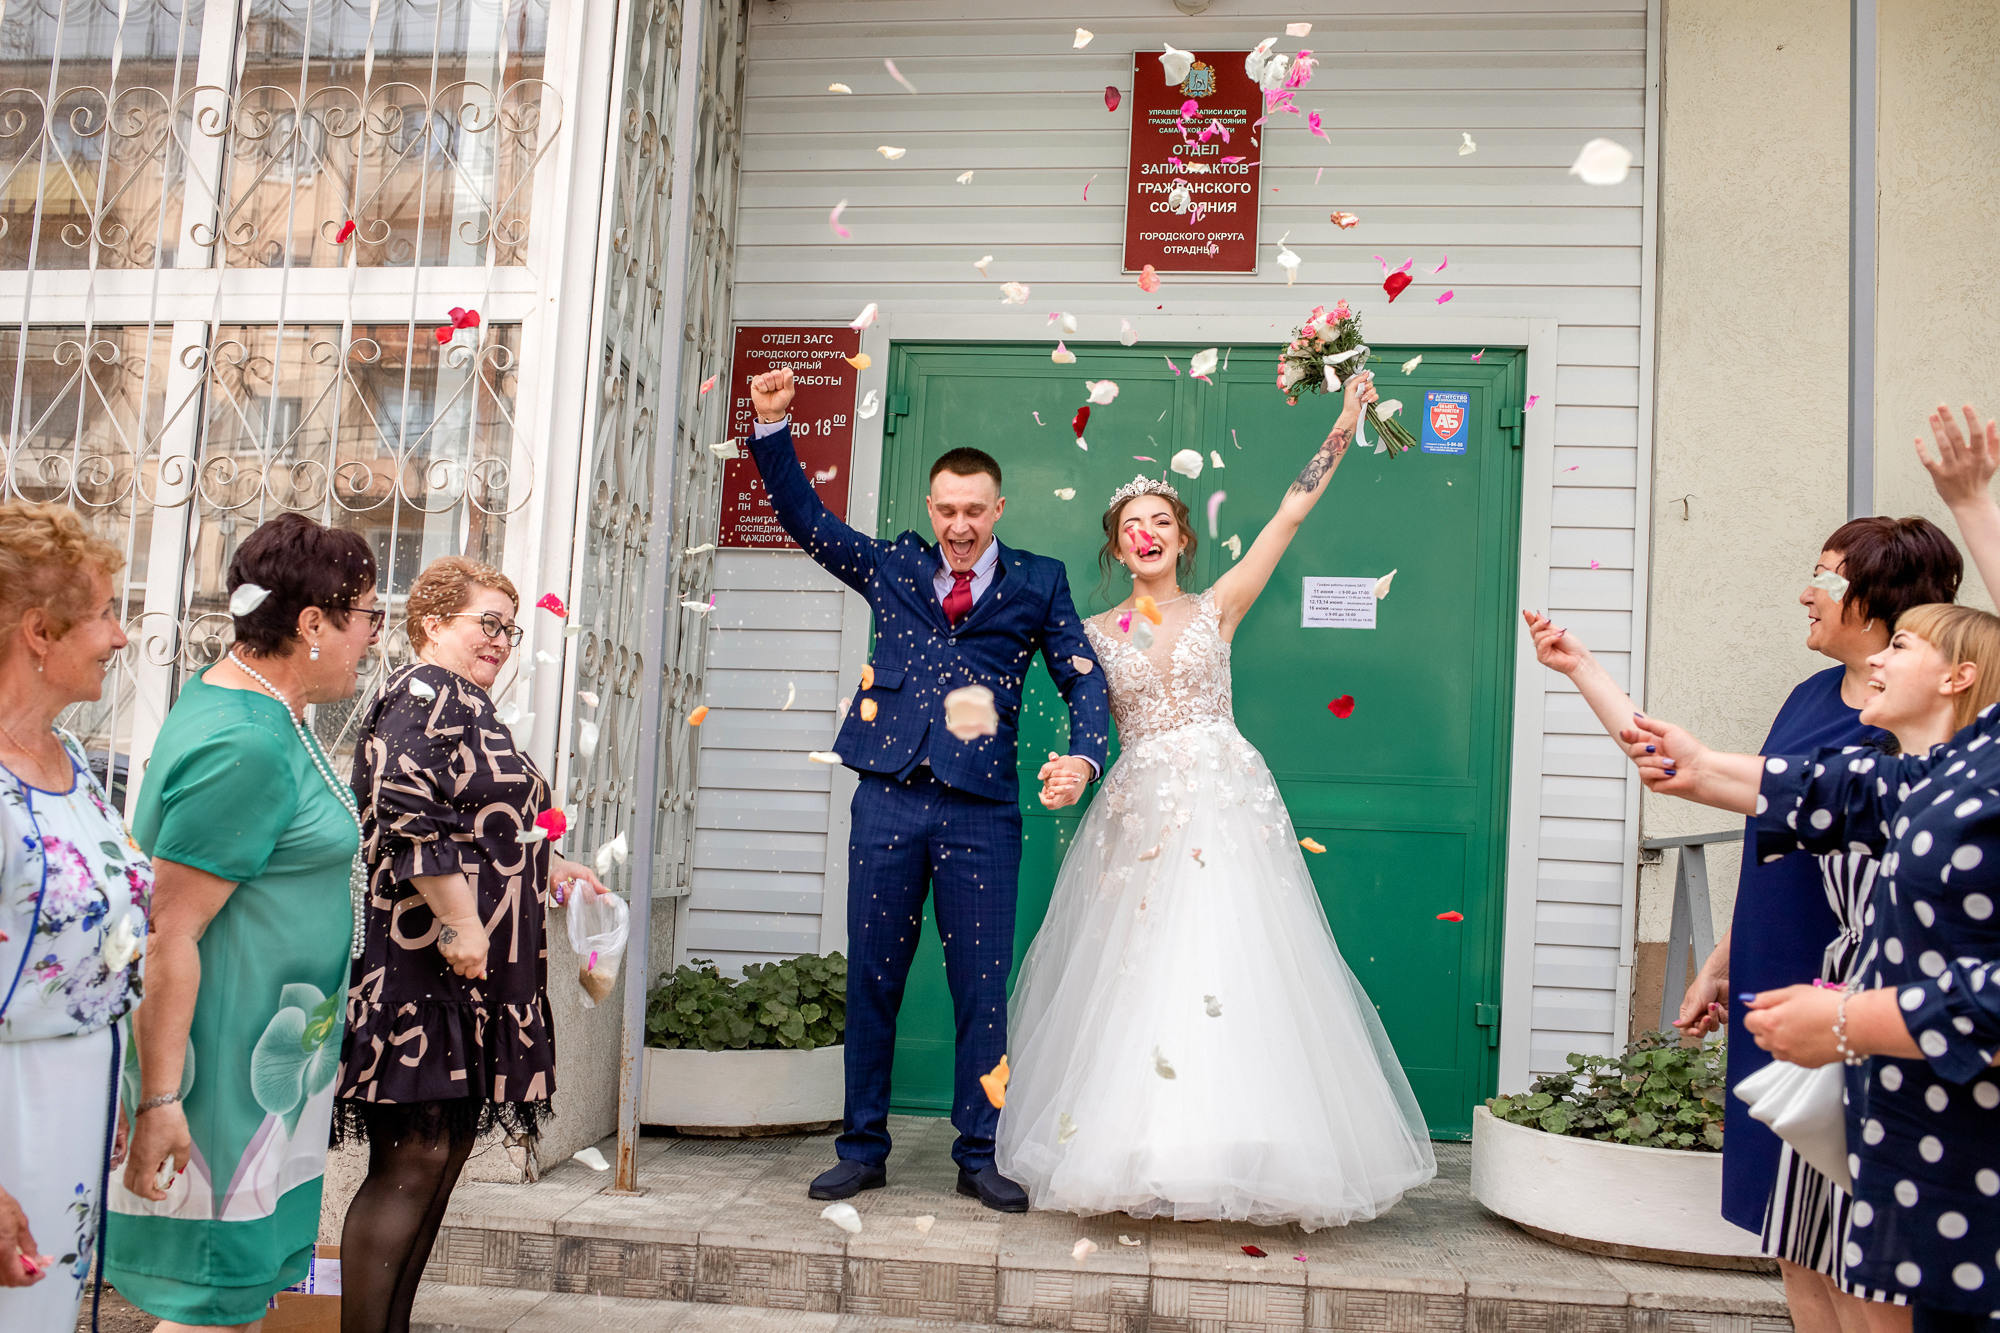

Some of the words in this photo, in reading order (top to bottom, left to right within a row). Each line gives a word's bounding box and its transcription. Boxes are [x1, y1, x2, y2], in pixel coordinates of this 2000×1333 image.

[1172, 144, 1219, 157] ОТДЕЛ
[1140, 163, 1199, 175] ЗАПИС
[1137, 182, 1252, 194] ГРАЖАНСКОГО
[1149, 201, 1237, 213] СООЯНИЯ
[1139, 232, 1206, 242] ГОРОДСКОГО
[1207, 232, 1245, 241] ОКРУГА
[761, 334, 801, 345] ОТДЕЛ
[803, 334, 834, 344] ЗАГС
[746, 350, 809, 360] ГОРОДСКОГО
[810, 350, 846, 359] ОКРУГА
[768, 360, 822, 370] ОТРАДНЫЙ
[793, 375, 842, 386] РАБОТЫ
[736, 397, 752, 408] ВТ
[735, 410, 752, 421] СР
[1434, 413, 1459, 429] АБ
[734, 421, 751, 433] ЧТ
[738, 492, 752, 501] ВС
[737, 502, 751, 511] ПН
[740, 533, 783, 543] КАЖДОГО
